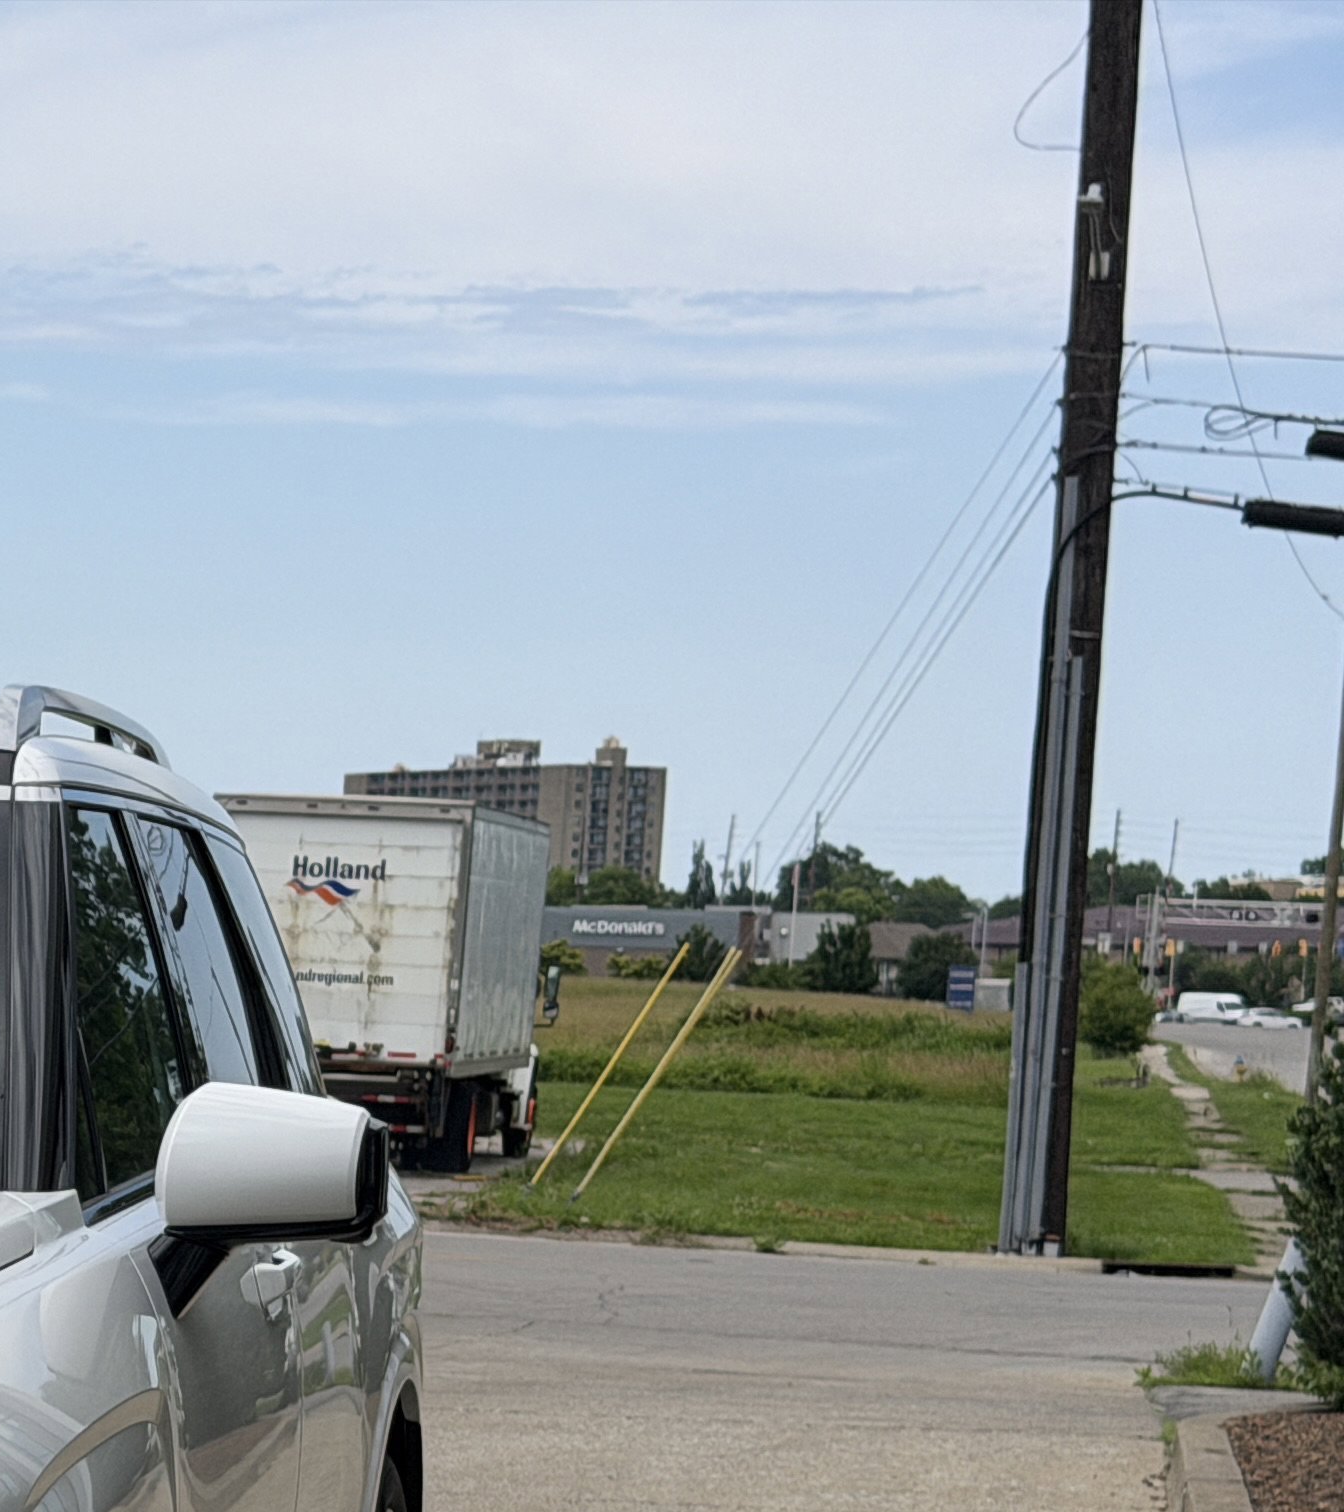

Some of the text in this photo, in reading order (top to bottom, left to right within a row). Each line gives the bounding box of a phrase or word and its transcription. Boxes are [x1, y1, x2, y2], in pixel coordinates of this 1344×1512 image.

[292, 855, 387, 881] Holland
[572, 919, 665, 936] McDonald's
[294, 968, 395, 987] ndregional.com
